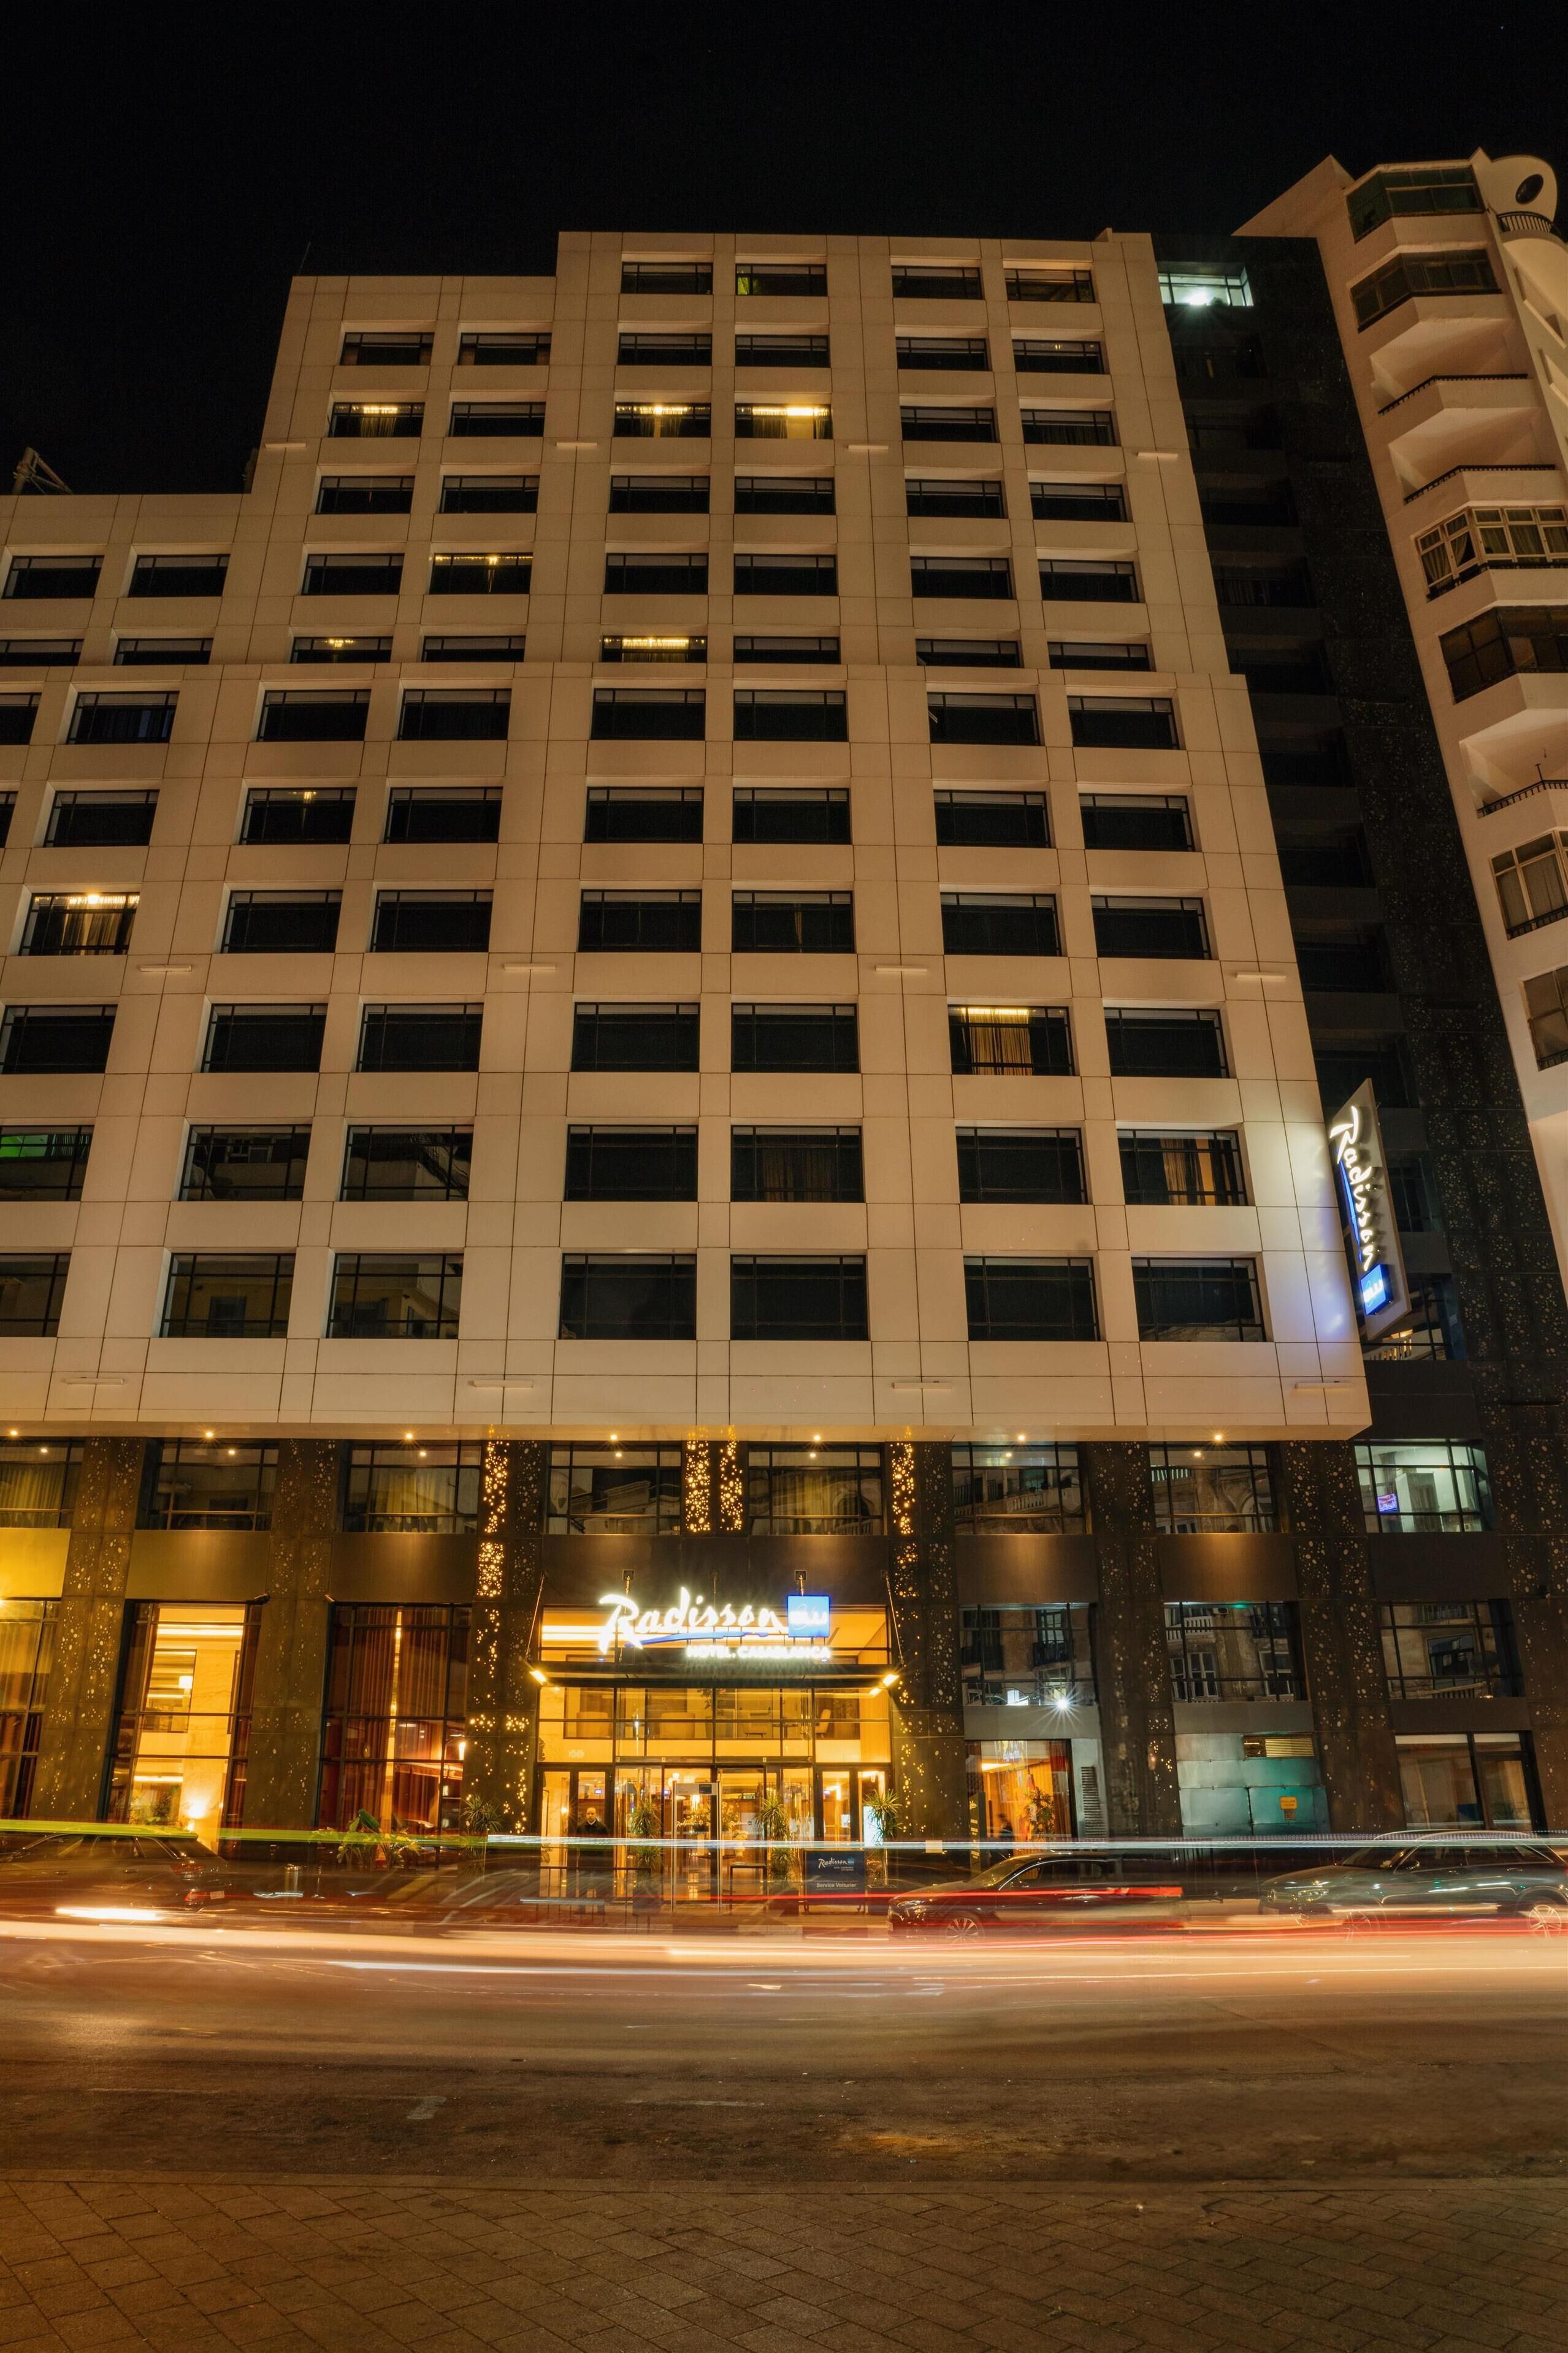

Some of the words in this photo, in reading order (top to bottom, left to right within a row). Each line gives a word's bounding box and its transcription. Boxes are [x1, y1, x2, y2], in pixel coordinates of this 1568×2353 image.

[1329, 1106, 1372, 1271] Radisson
[599, 1586, 789, 1655] Radisson
[818, 1857, 847, 1869] Radisson
